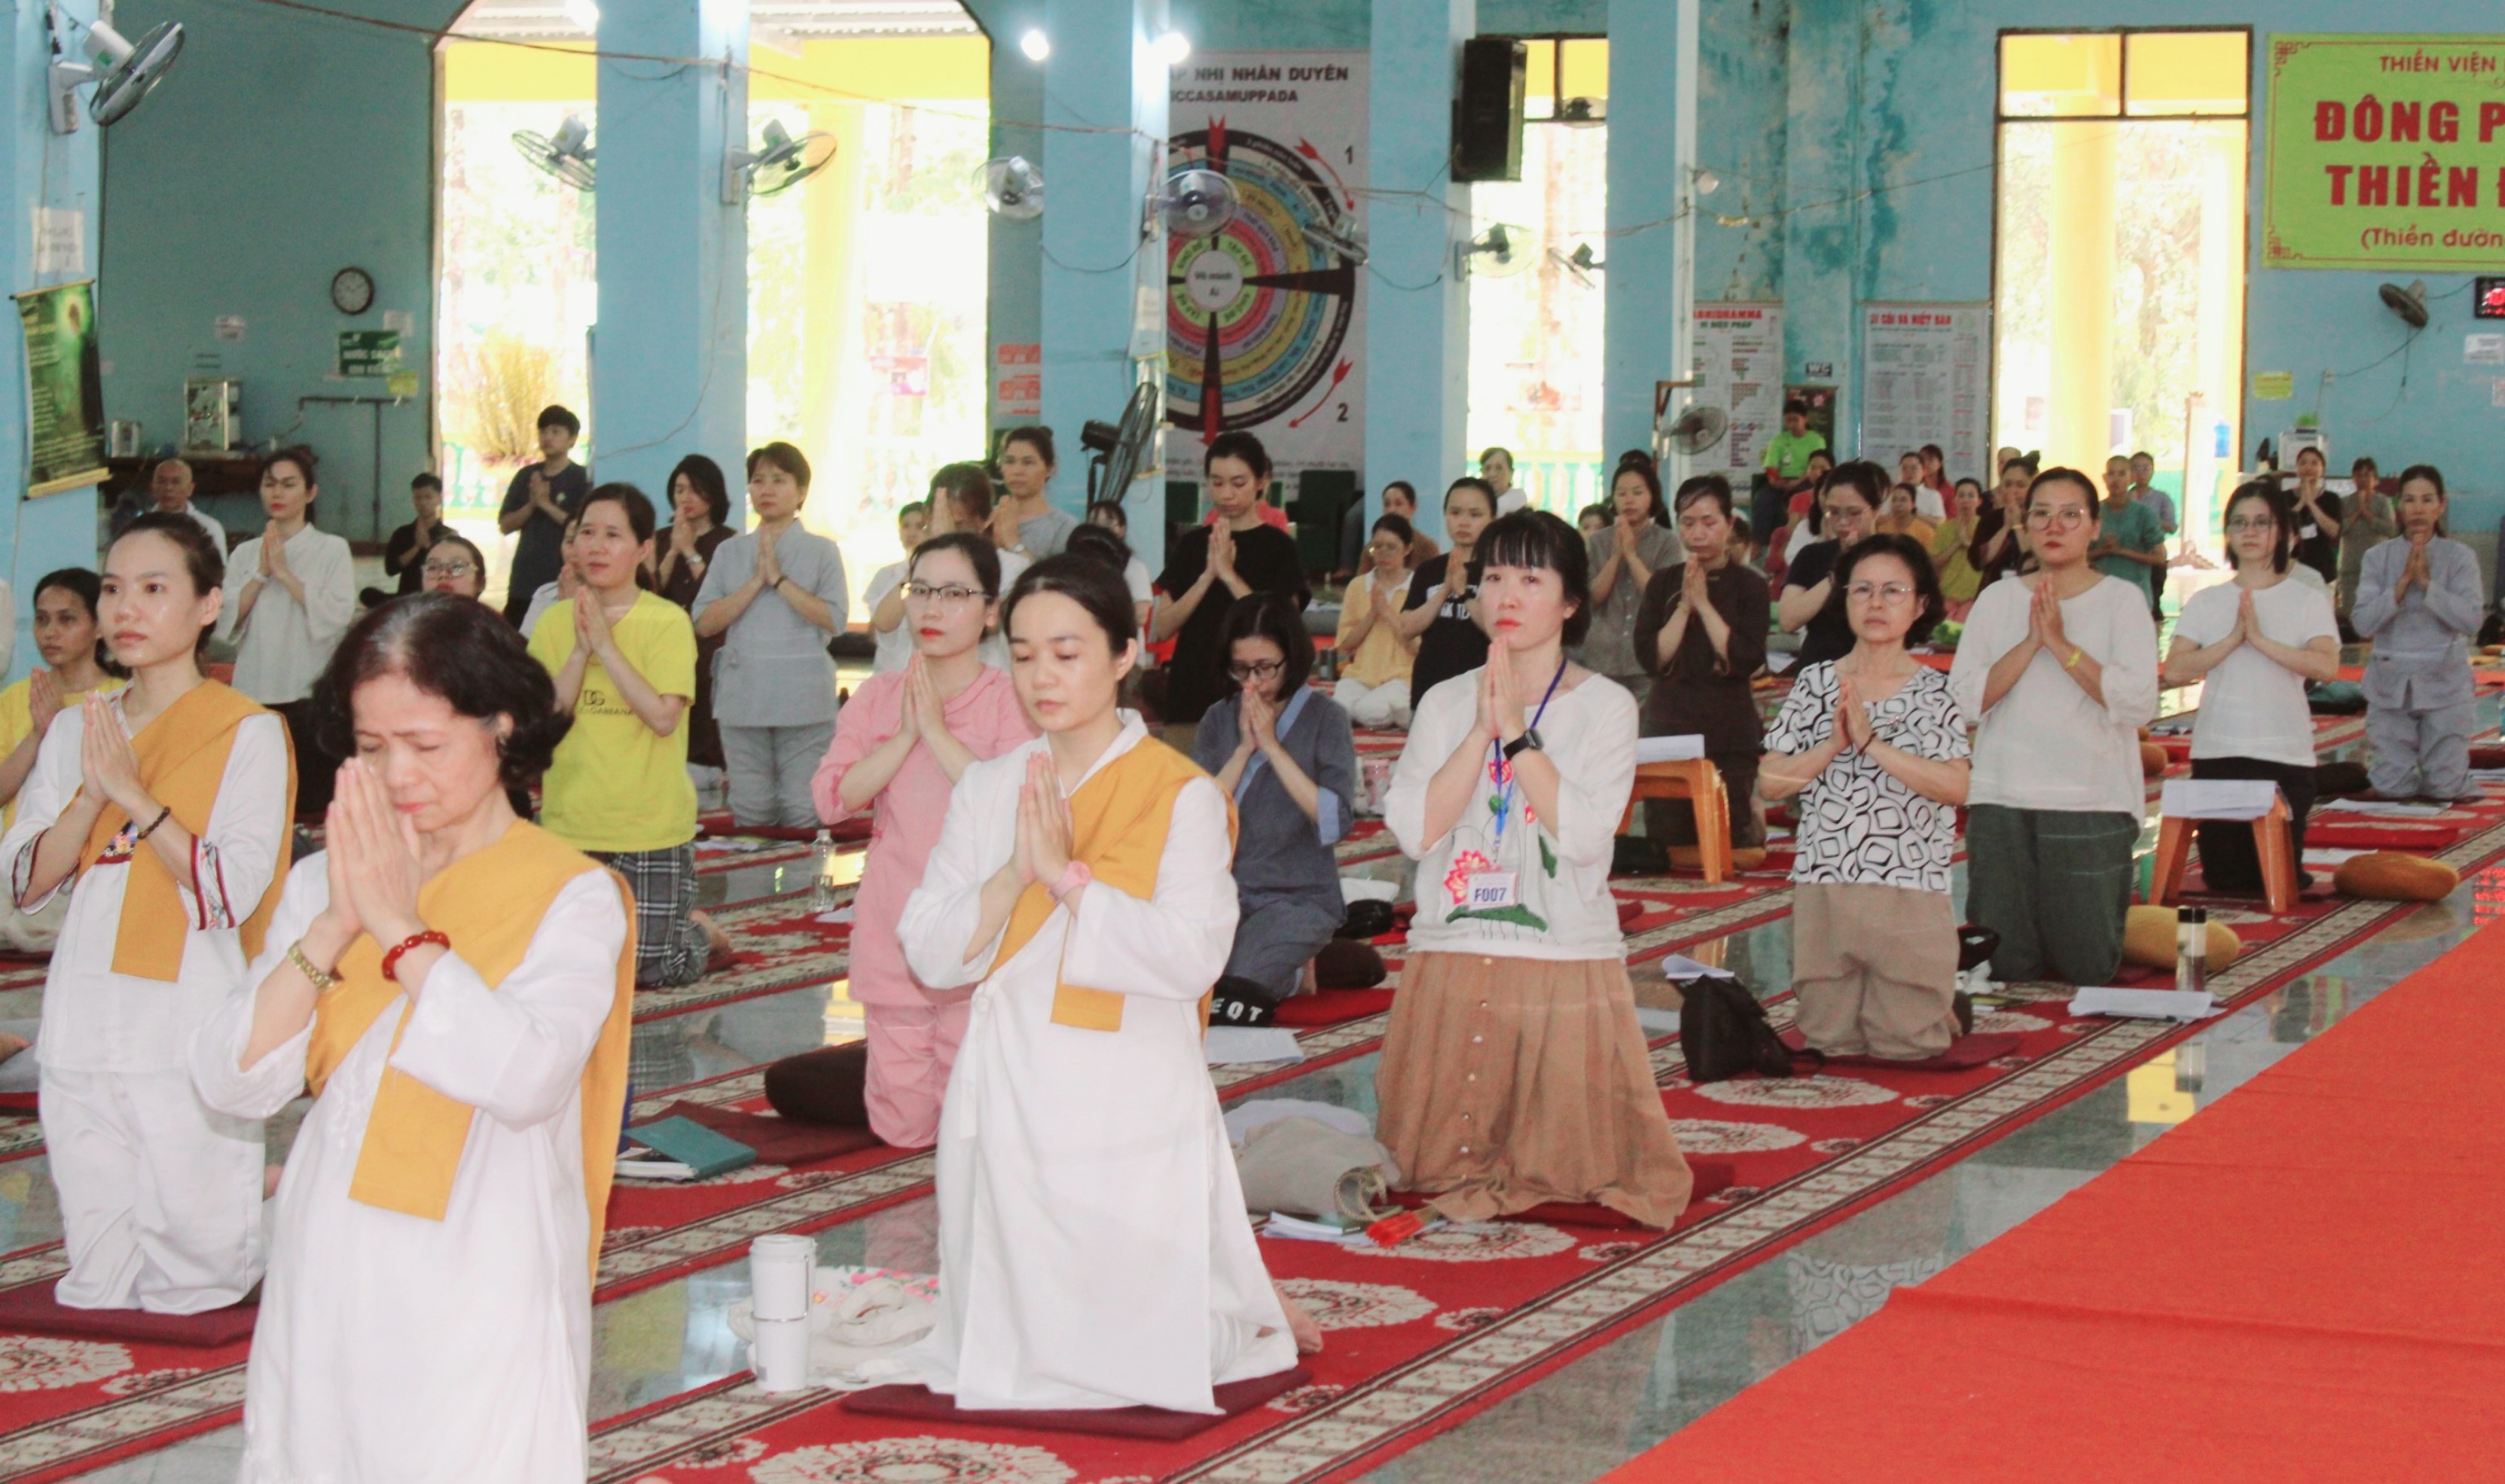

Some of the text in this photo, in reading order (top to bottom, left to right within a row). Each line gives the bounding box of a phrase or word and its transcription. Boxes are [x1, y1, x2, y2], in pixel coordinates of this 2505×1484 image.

[1232, 64, 1281, 81] NHÂN
[1289, 64, 1348, 81] DUYÊN
[2447, 50, 2496, 77] VIỆN
[2314, 93, 2459, 143] ĐÔNG
[1344, 145, 1353, 164] 1
[2325, 151, 2479, 207] THIỀN
[2442, 227, 2505, 248] đườn
[1337, 402, 1348, 422] 2
[1474, 887, 1507, 902] F007
